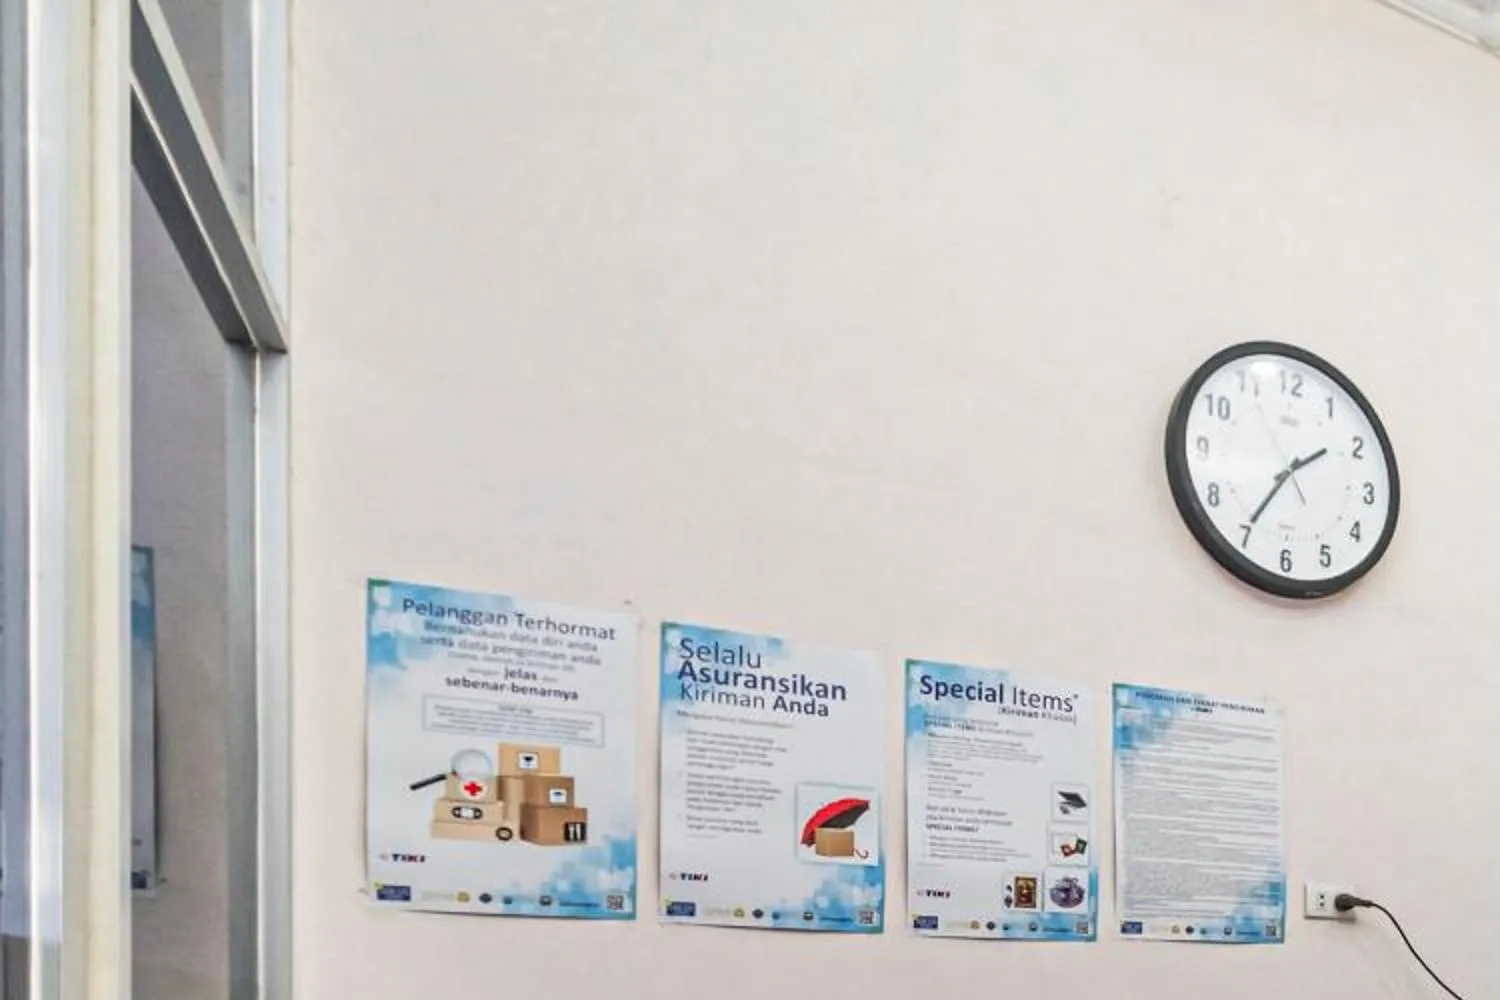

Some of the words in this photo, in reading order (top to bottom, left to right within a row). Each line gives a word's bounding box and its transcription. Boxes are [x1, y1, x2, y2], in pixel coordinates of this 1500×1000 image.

[1279, 370, 1303, 397] 12
[1203, 393, 1231, 421] 10
[1325, 397, 1334, 419] 1
[1196, 435, 1210, 461] 9
[1351, 436, 1364, 459] 2
[1206, 482, 1220, 507] 8
[1362, 482, 1376, 505] 3
[1239, 524, 1253, 550] 7
[1349, 520, 1362, 543] 4
[1279, 549, 1293, 573] 6
[1319, 544, 1332, 568] 5
[402, 597, 508, 627] Pelanggan
[514, 611, 617, 641] Terhormat
[679, 637, 763, 670] Selalu
[504, 667, 537, 681] jelas
[677, 659, 847, 701] Asuransikan
[681, 682, 765, 709] Kiriman
[772, 695, 829, 718] Anda
[919, 674, 1004, 704] Special
